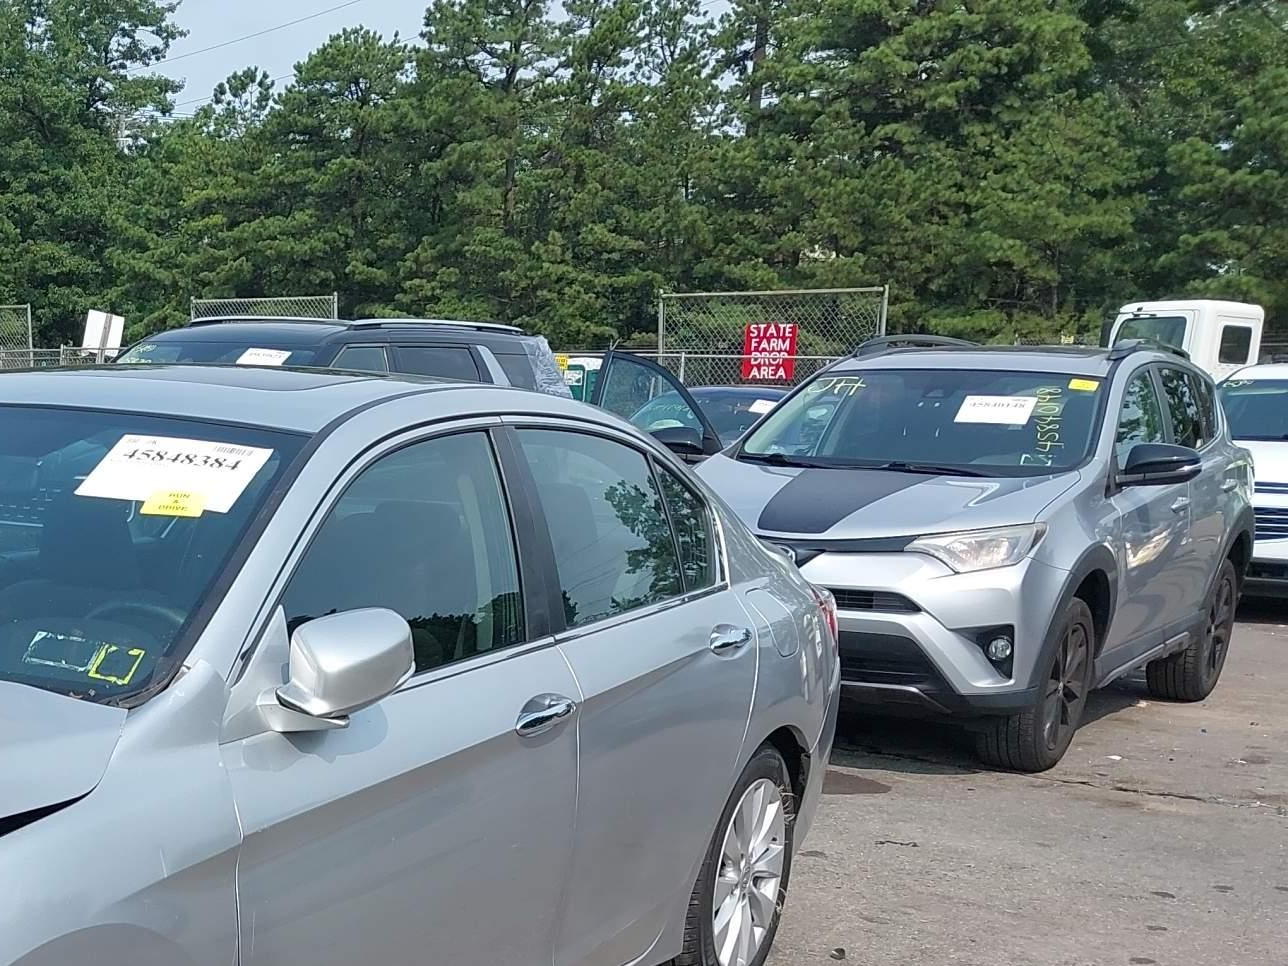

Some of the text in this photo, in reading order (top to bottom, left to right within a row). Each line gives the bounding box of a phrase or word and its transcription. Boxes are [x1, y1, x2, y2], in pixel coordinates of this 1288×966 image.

[749, 324, 794, 337] STATE
[750, 338, 791, 351] FARM
[750, 352, 789, 365] DROP
[748, 366, 787, 379] AREA
[123, 448, 242, 471] 45848384
